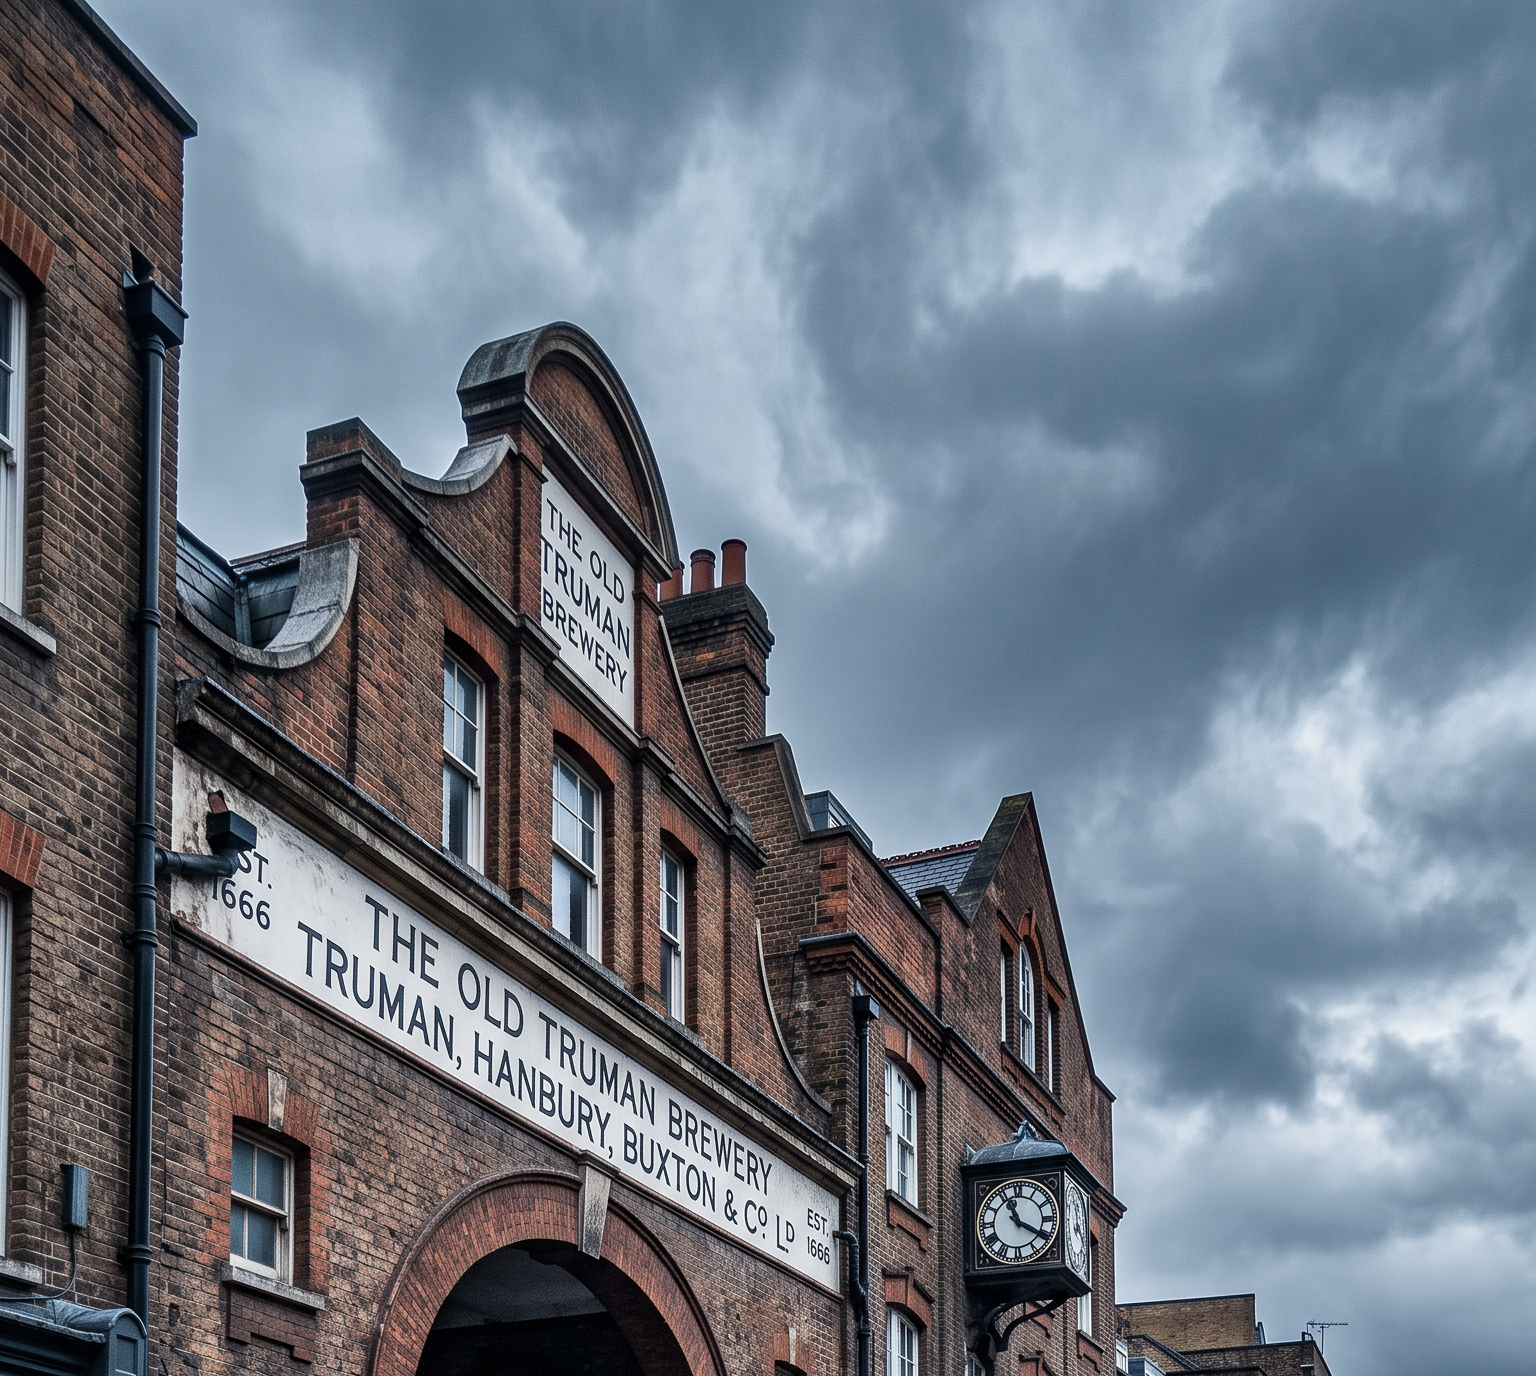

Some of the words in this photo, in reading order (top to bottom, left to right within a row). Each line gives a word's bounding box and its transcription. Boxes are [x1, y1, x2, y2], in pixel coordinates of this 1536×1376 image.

[541, 533, 631, 659] TRUMAN
[546, 498, 582, 562] THE
[590, 550, 625, 605] OLD
[543, 586, 628, 694] BREWERY
[212, 876, 270, 930] 1666
[237, 850, 272, 890] ST.
[297, 921, 462, 1070] TRUMAN,
[473, 1031, 613, 1160] HANBURY,
[623, 1122, 716, 1212] BUXTON
[724, 1189, 738, 1225] &
[365, 894, 439, 989] THE
[457, 962, 524, 1038] OLD
[538, 1011, 656, 1125] TRUMAN
[668, 1098, 772, 1196] BREWERY
[807, 1207, 829, 1238] EST.
[807, 1236, 830, 1265] 1666
